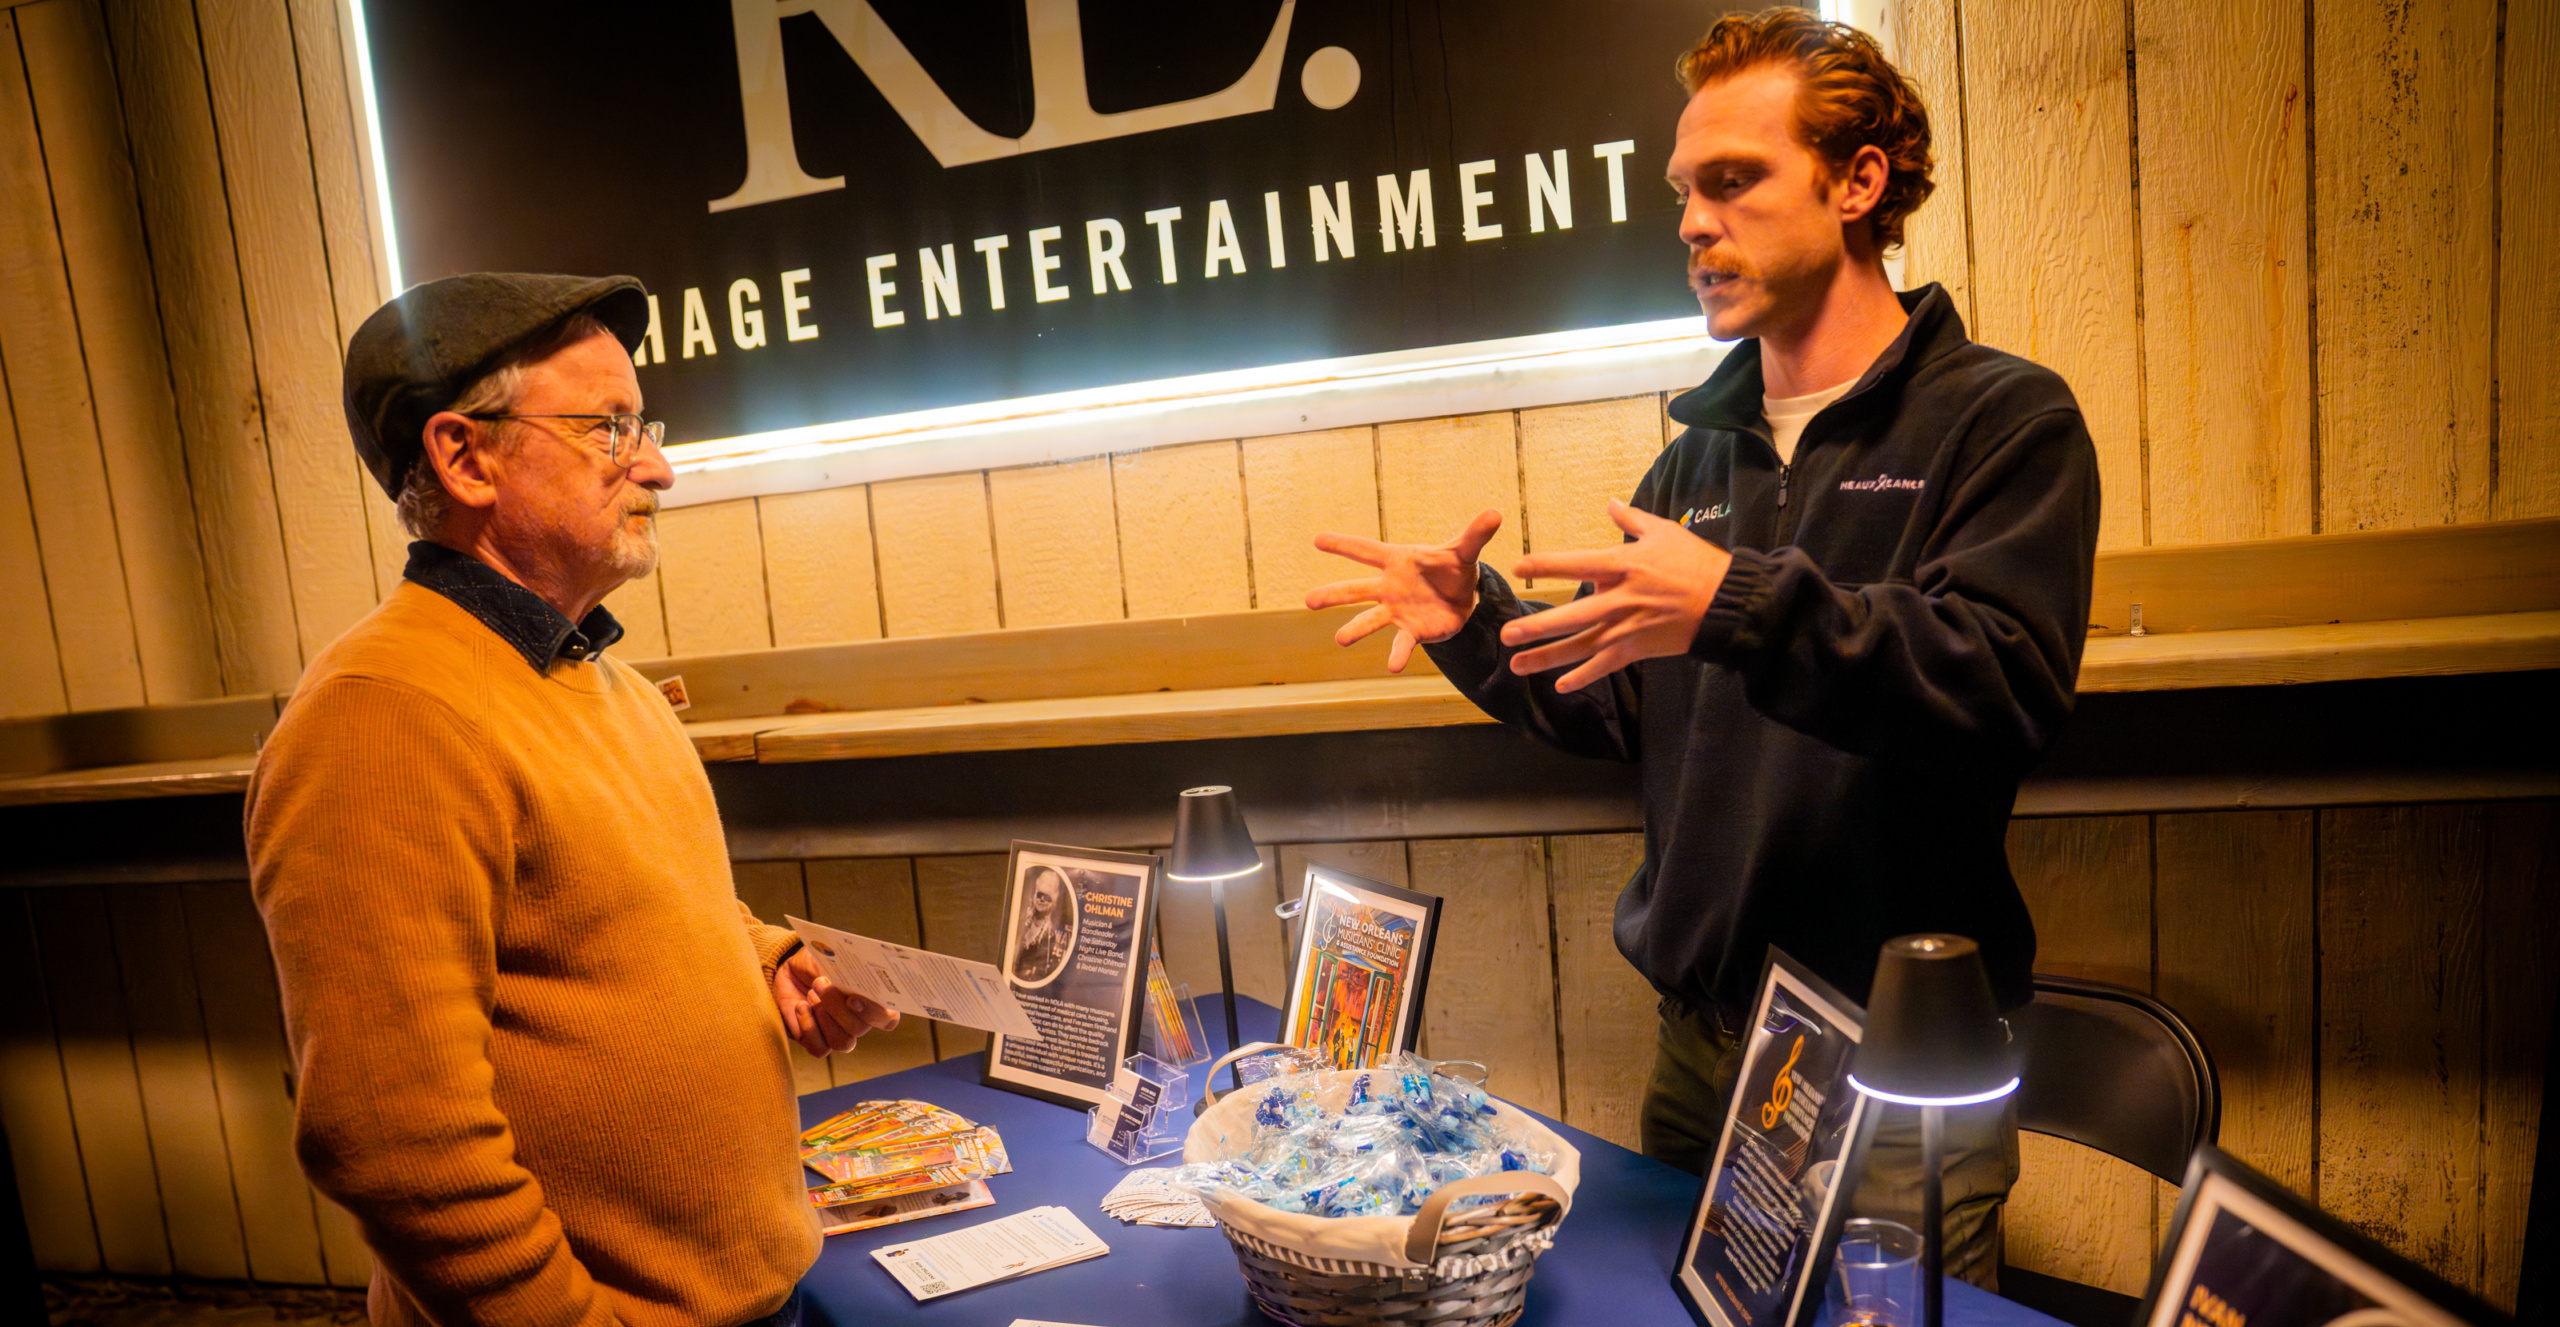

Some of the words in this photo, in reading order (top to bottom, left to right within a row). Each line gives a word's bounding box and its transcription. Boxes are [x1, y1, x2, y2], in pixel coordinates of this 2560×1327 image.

[864, 138, 1636, 330] ENTERTAINMENT
[1085, 891, 1134, 908] CHRISTINE
[1084, 903, 1124, 918] OHLMAN
[1082, 918, 1108, 928] Musician
[1339, 914, 1360, 930] NEW
[1362, 922, 1404, 946] ORLEANS
[1081, 927, 1114, 938] Bandleader
[1078, 944, 1095, 956] Night
[1095, 948, 1107, 956] Live
[1080, 936, 1091, 944] The
[1091, 938, 1118, 950] Saturday
[1376, 942, 1401, 959] CLINIC
[1078, 954, 1103, 964] Christine
[1103, 958, 1127, 968] Ohlman
[1340, 941, 1366, 956] ASSISTANCE
[1367, 950, 1400, 968] FOUNDATION
